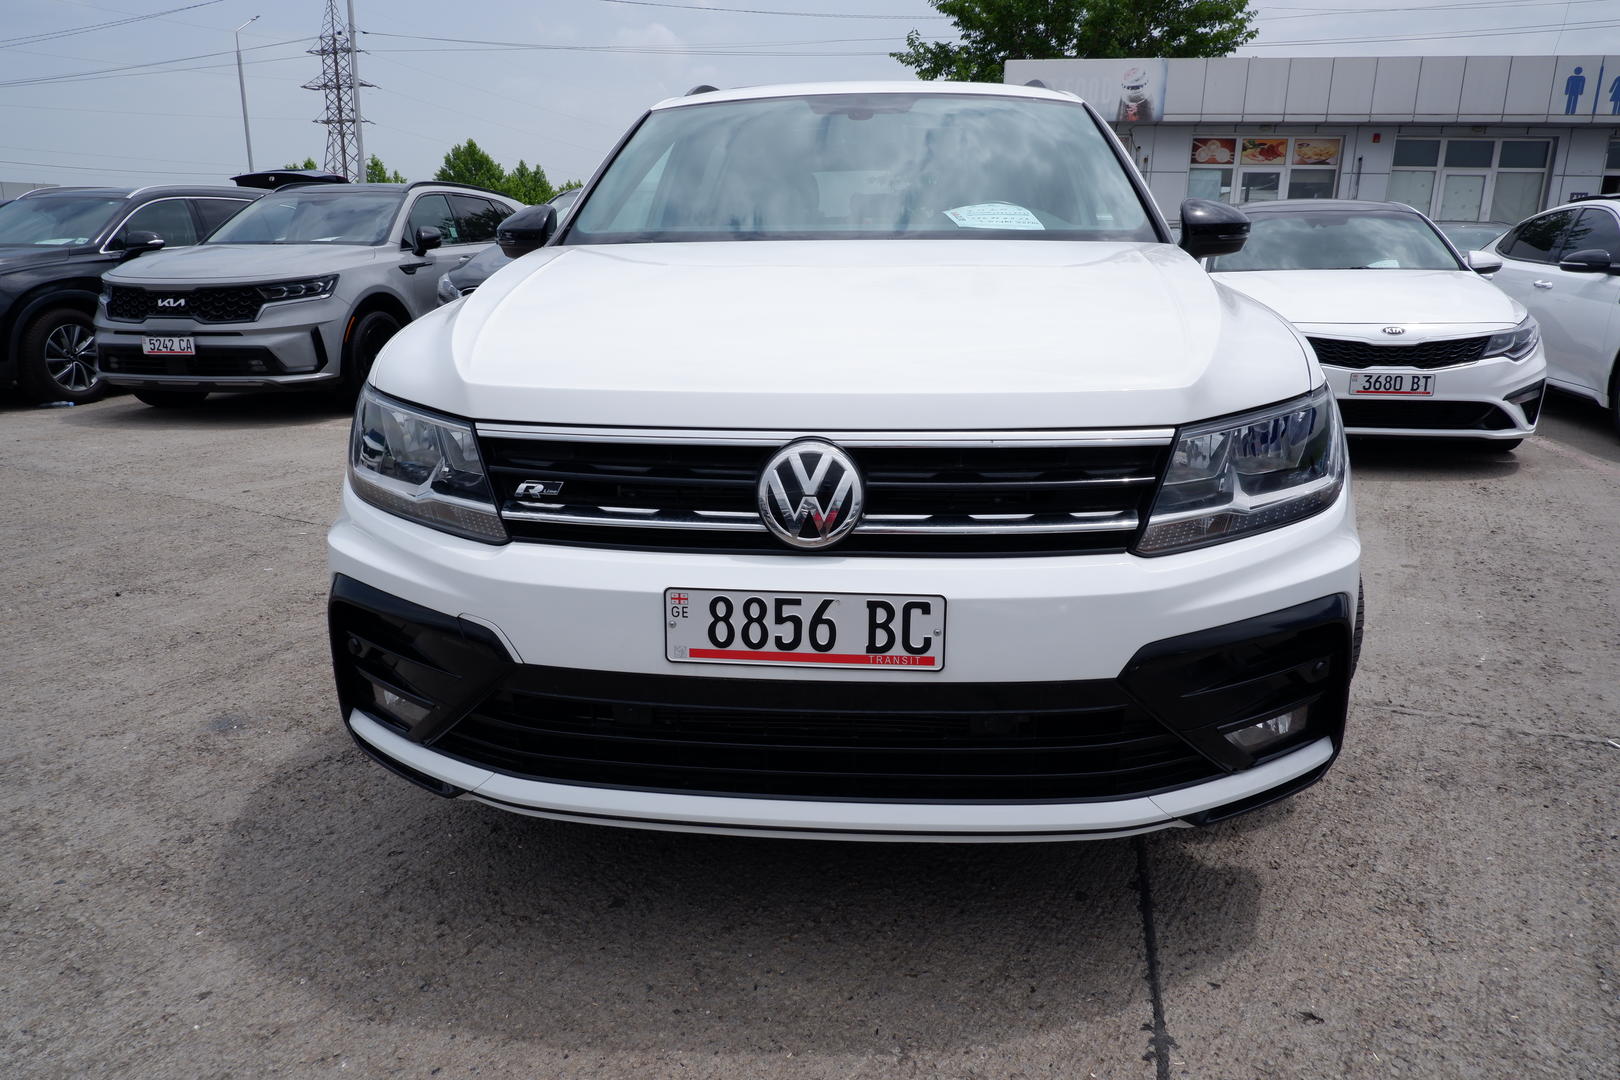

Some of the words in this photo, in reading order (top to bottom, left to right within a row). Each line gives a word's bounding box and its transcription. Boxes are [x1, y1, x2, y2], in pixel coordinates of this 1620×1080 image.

[158, 298, 185, 307] KIA
[148, 338, 175, 351] 5242
[178, 338, 193, 351] CA
[1362, 375, 1404, 391] 3680
[1410, 376, 1432, 391] BT
[671, 605, 689, 618] GE
[707, 596, 837, 653] 8856
[865, 599, 933, 656] BC
[868, 655, 921, 665] TRANSIT
